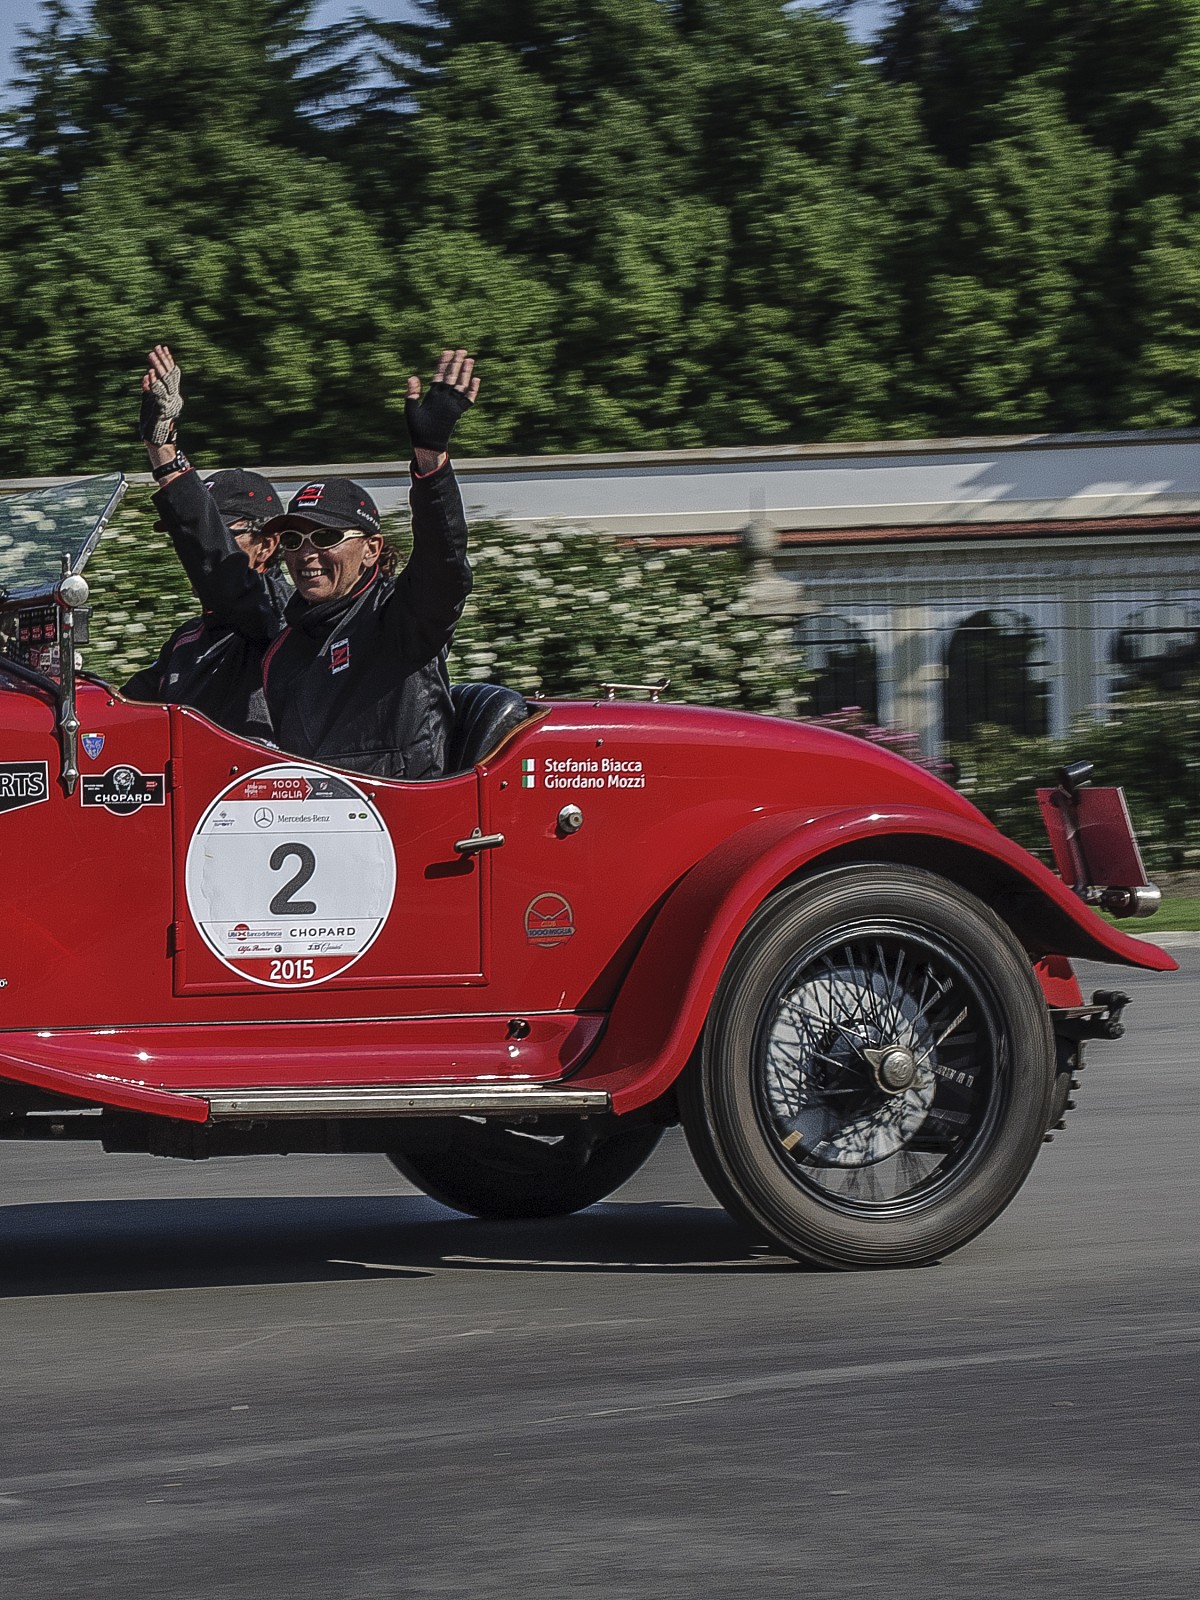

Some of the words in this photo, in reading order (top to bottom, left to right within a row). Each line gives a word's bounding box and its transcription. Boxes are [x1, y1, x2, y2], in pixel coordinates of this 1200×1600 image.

[544, 758, 599, 772] Stefania
[601, 758, 643, 772] Biacca
[272, 780, 301, 789] 1000
[544, 774, 605, 789] Giordano
[607, 774, 646, 789] Mozzi
[94, 793, 152, 802] CHOPARD
[271, 790, 303, 799] MIGLIA
[277, 814, 331, 823] Mercedes-Benz
[269, 842, 317, 915] 2
[289, 927, 356, 937] CHOPARD
[269, 959, 315, 980] 2015
